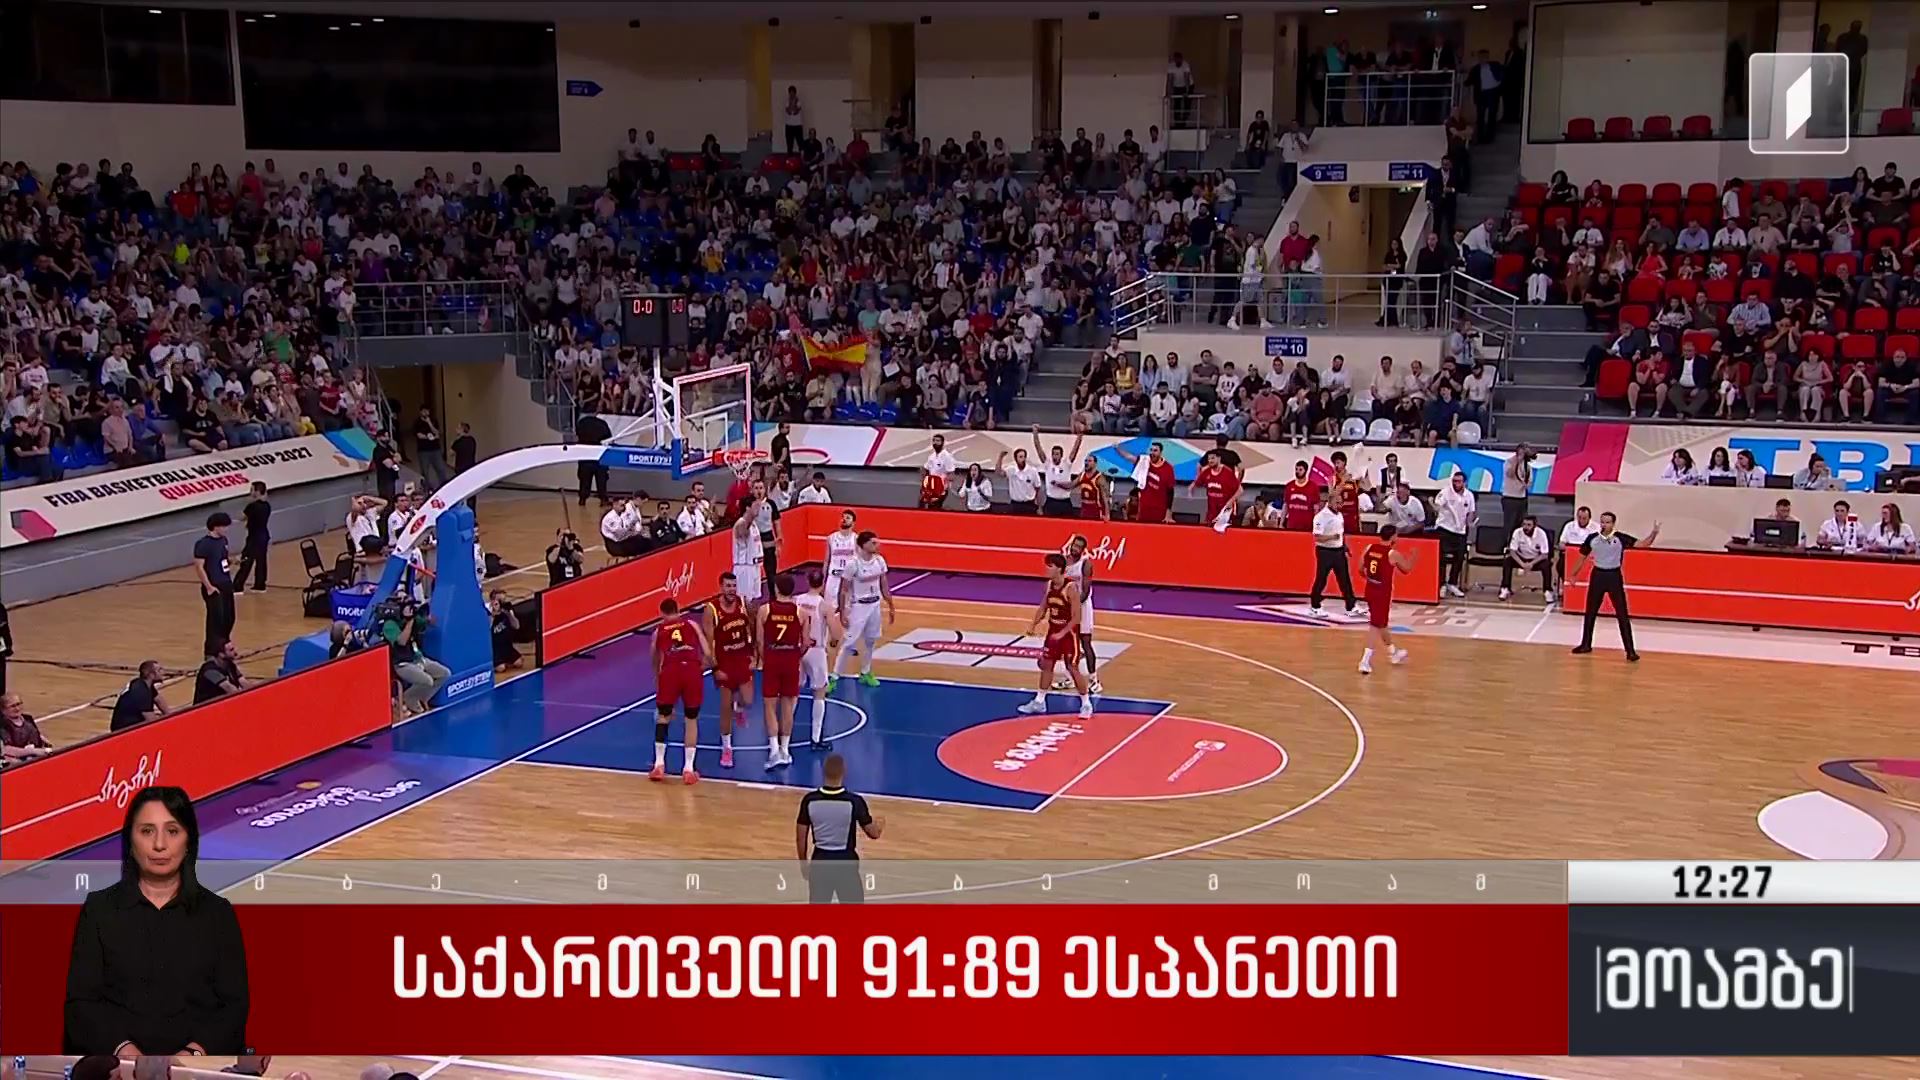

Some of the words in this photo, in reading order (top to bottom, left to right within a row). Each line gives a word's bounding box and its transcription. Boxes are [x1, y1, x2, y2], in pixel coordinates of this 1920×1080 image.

[1290, 344, 1304, 355] 10
[43, 489, 93, 508] FIBA
[90, 468, 193, 500] BASKETBALL
[191, 458, 248, 478] WORLD
[244, 451, 277, 468] CUP
[273, 446, 314, 462] 2027
[158, 473, 250, 501] QUALIFIERS
[671, 629, 682, 642] 4
[776, 623, 787, 641] 7
